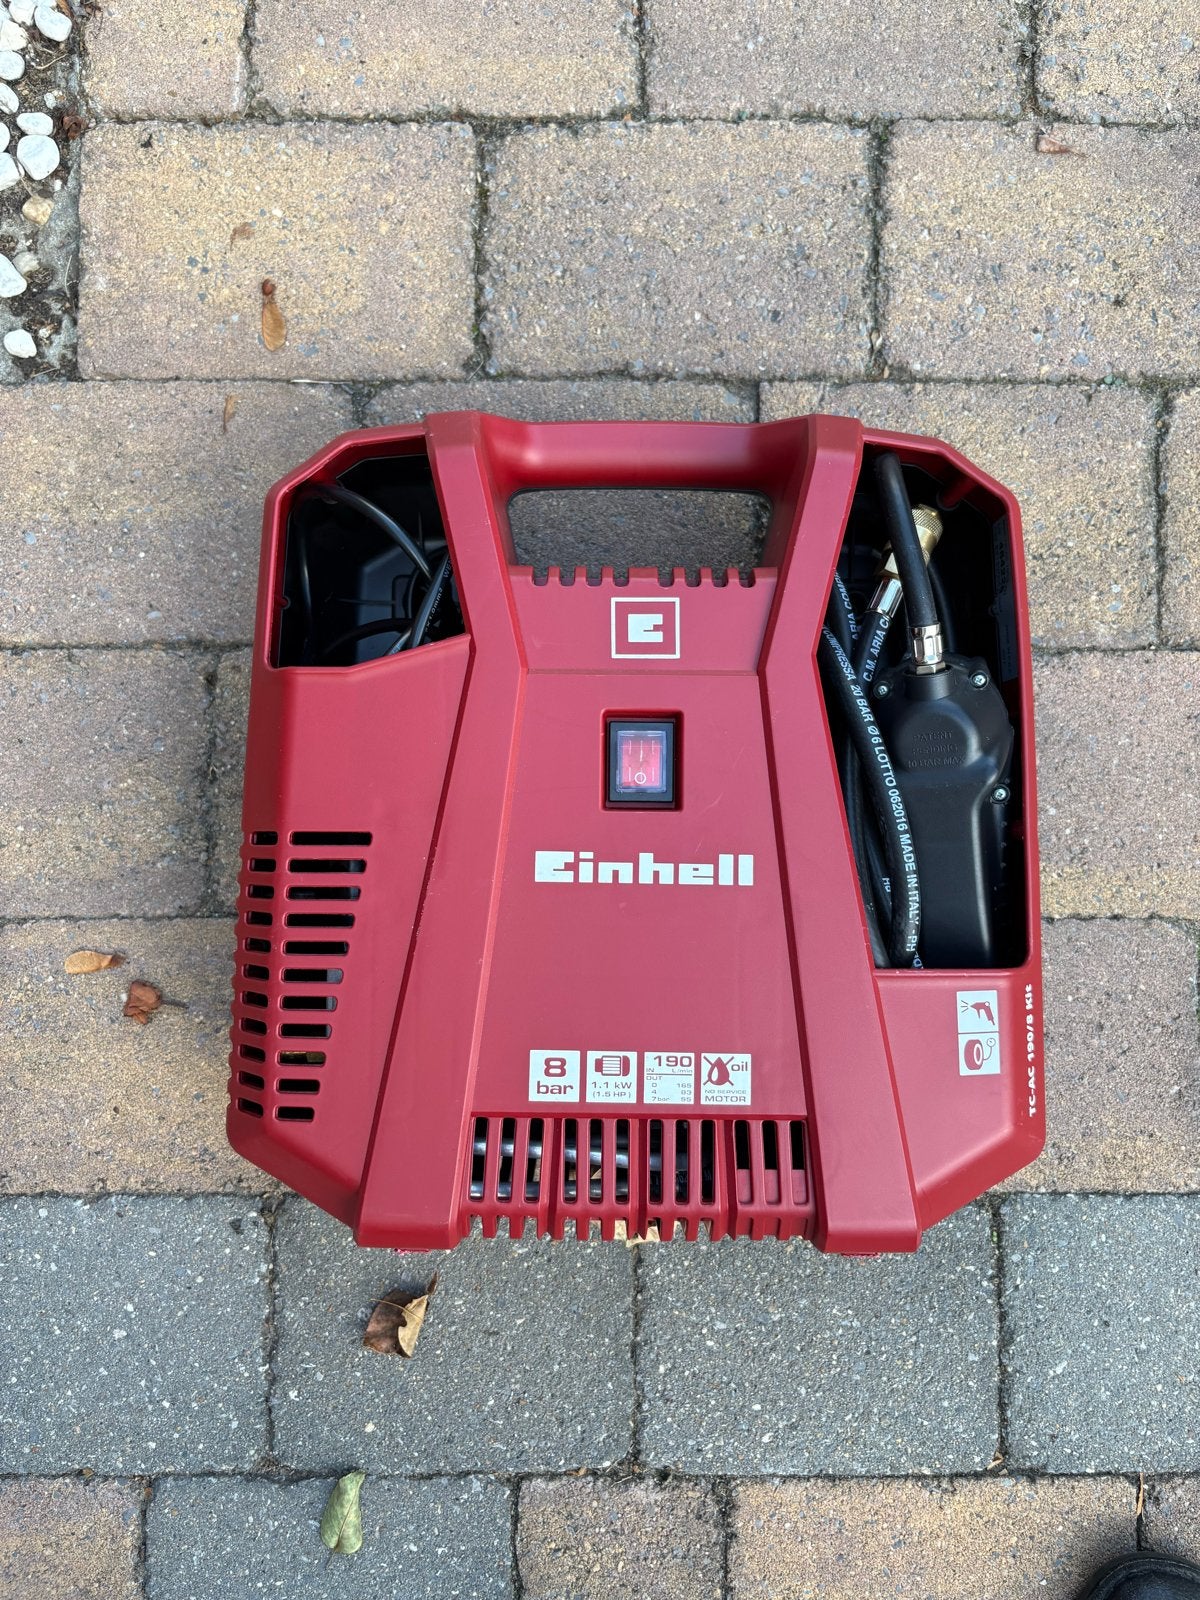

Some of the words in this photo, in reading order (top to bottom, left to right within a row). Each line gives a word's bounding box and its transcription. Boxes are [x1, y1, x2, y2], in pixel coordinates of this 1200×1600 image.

[870, 630, 886, 658] ARIA
[850, 684, 863, 697] 20
[856, 698, 874, 722] BAR
[874, 746, 897, 787] LOTTO
[888, 788, 908, 831] 062016
[899, 833, 916, 872] MADE
[534, 850, 754, 886] Einhell
[906, 874, 918, 888] IN
[908, 890, 920, 925] ITALY
[1026, 1013, 1035, 1062] 190/8
[544, 1057, 566, 1077] 8
[653, 1055, 692, 1067] 190
[730, 1061, 748, 1072] oil
[536, 1080, 574, 1094] bar
[614, 1081, 632, 1089] kW
[1028, 1065, 1037, 1117] TC-AC
[704, 1095, 747, 1103] MOTOR
